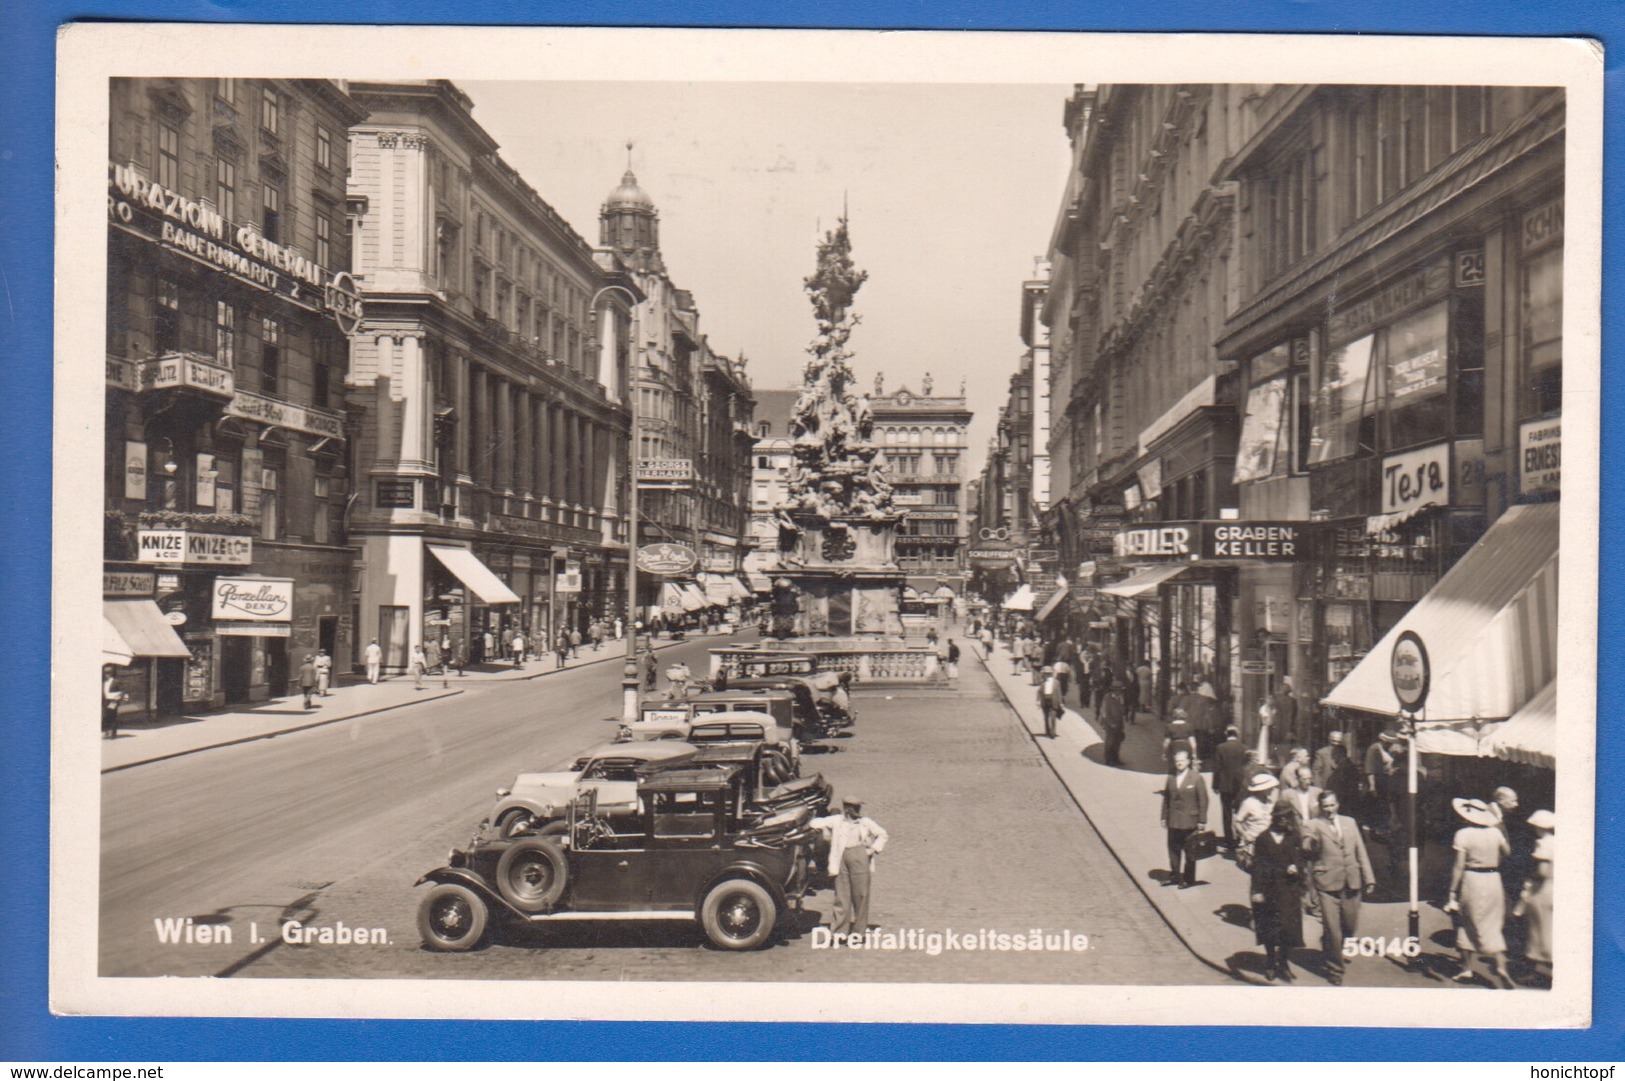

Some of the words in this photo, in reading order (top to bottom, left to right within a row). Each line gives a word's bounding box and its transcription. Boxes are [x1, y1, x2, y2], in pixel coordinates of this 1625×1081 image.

[161, 220, 279, 290] BAUERNMARKT
[1214, 526, 1299, 541] GRABEN-
[142, 534, 183, 549] KNIŽE
[1214, 541, 1296, 556] KELLER
[217, 583, 288, 612] Porzellan
[245, 602, 275, 612] DENK
